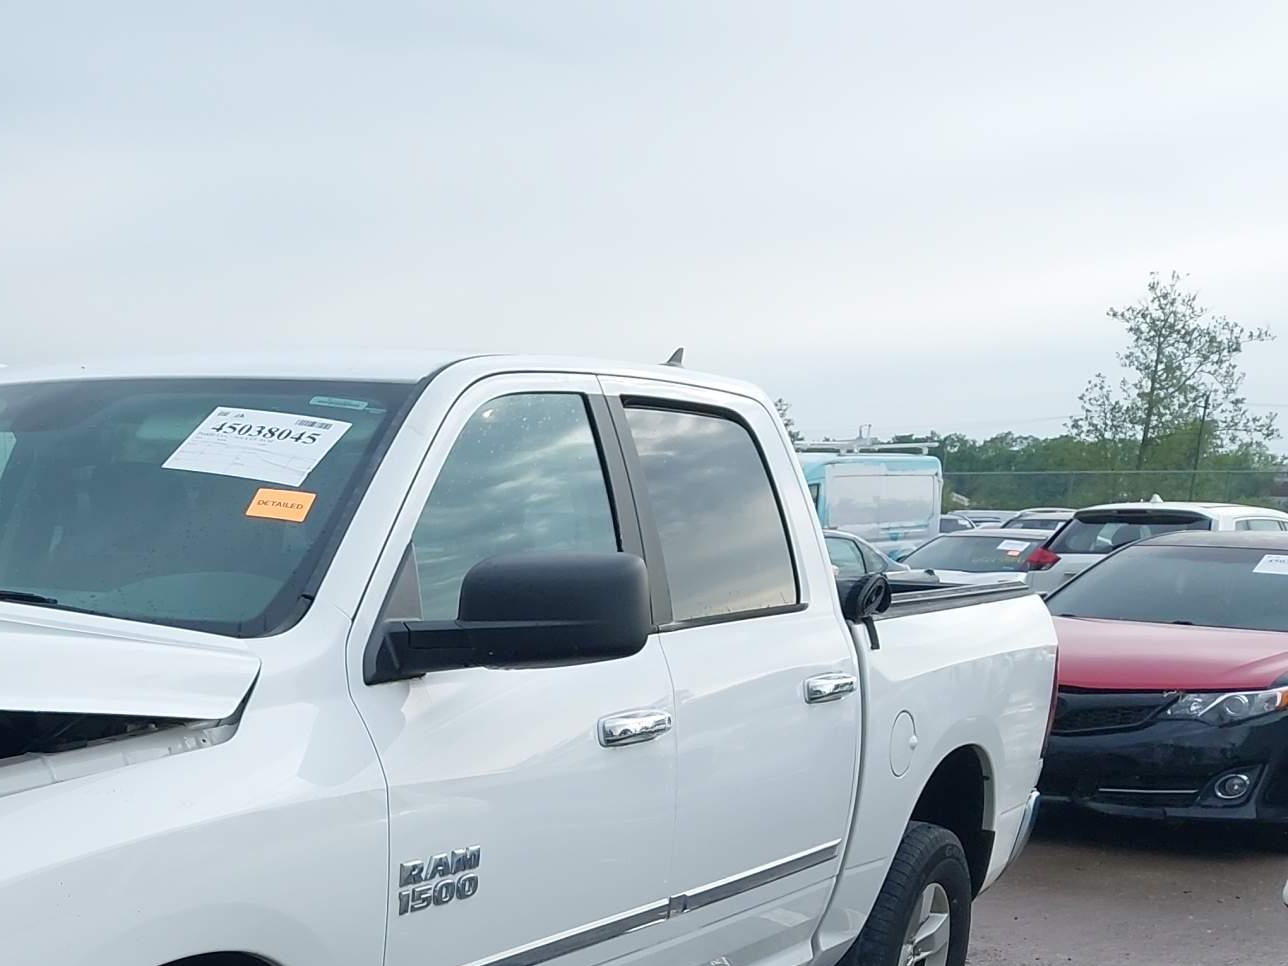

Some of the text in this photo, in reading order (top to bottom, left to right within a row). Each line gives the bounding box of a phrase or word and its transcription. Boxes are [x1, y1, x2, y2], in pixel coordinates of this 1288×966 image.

[211, 421, 321, 445] 45038045
[257, 499, 304, 511] DETAILED
[399, 845, 480, 887] RAM
[399, 873, 479, 916] 1500
